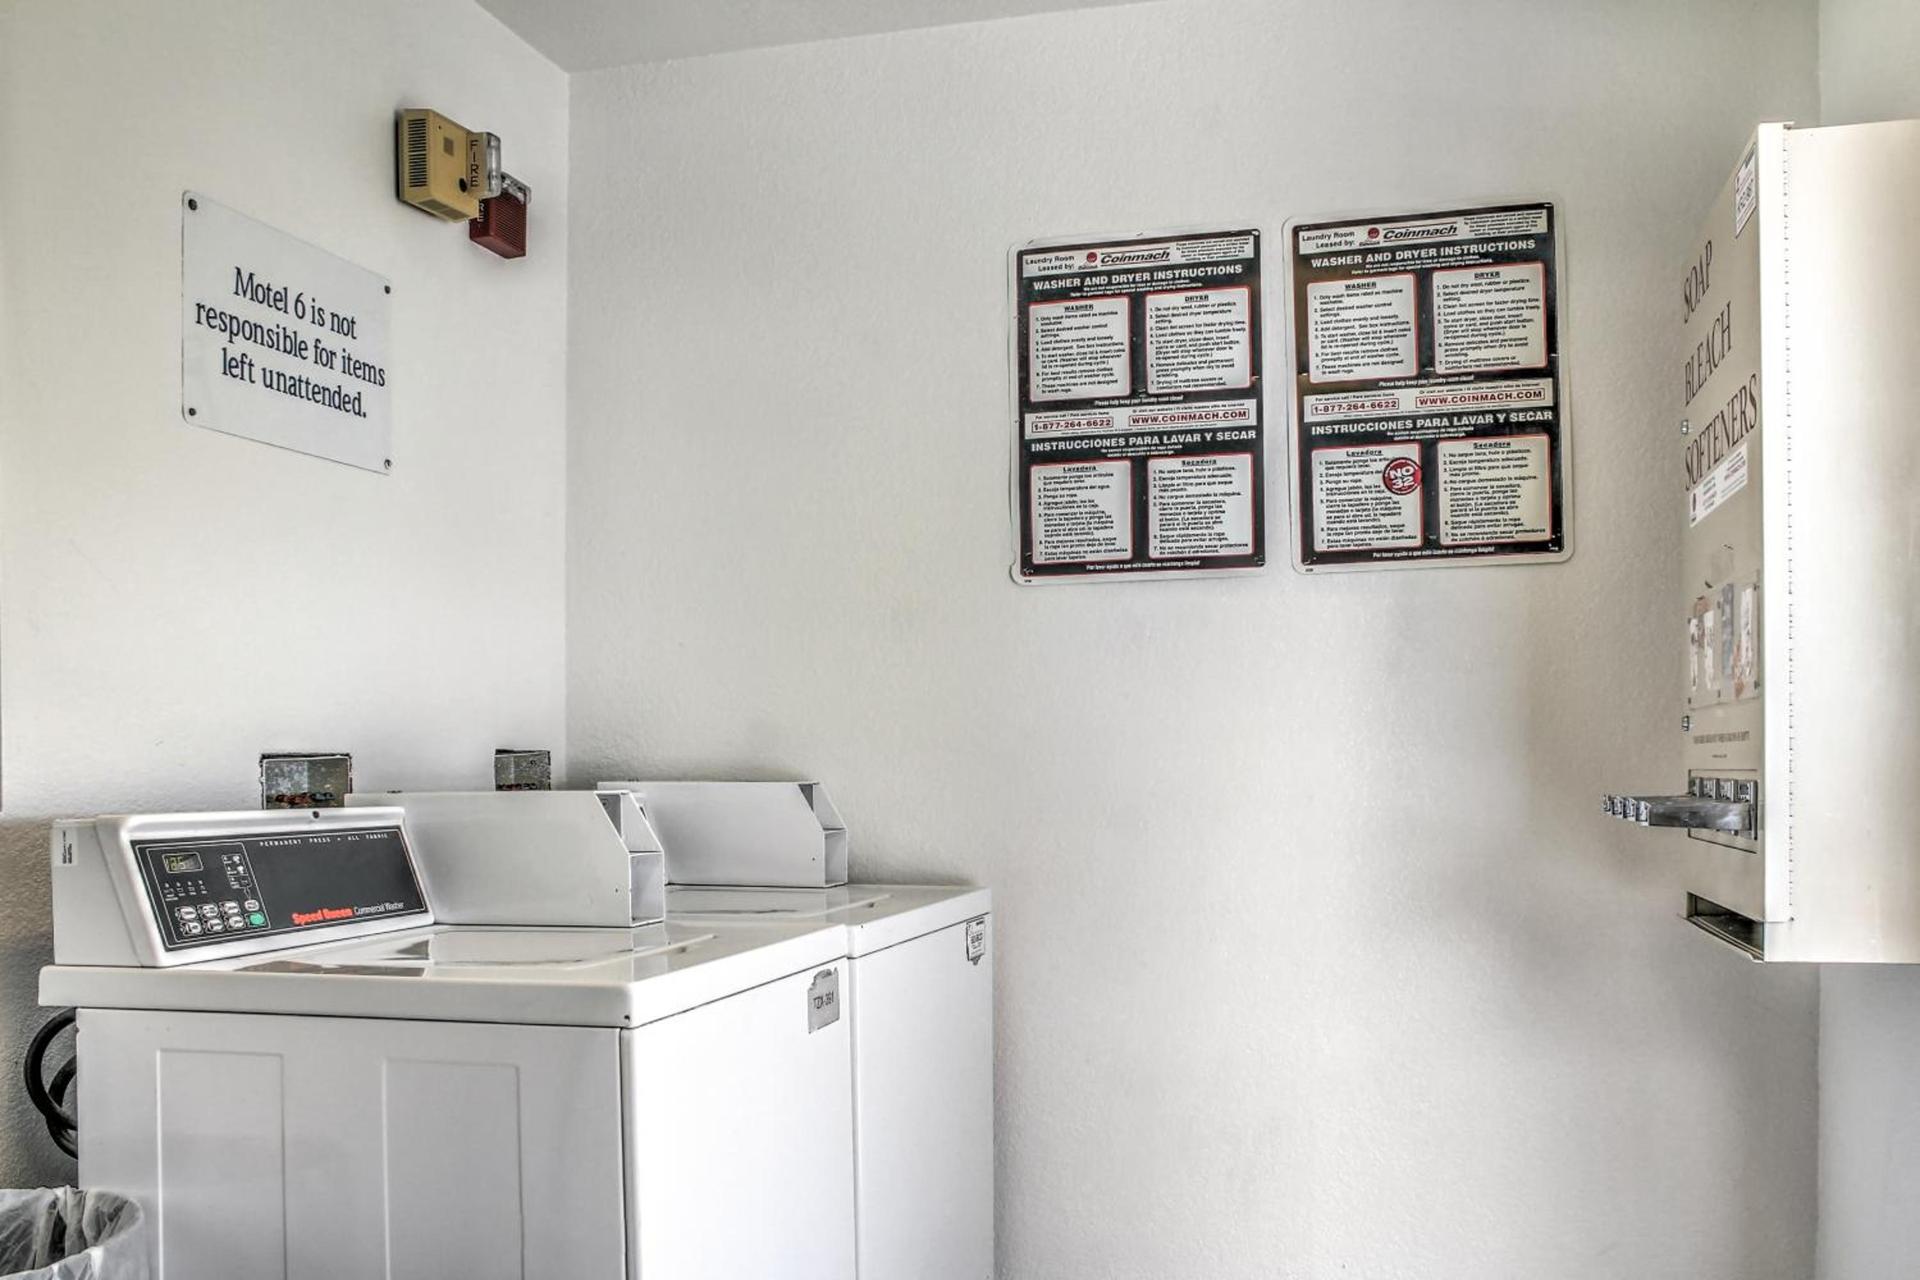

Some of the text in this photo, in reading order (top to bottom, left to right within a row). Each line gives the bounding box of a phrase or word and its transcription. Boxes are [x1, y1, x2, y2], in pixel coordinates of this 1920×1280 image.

[470, 140, 480, 187] FIRE
[1302, 233, 1332, 241] Laundry
[1383, 225, 1457, 239] Coinmach
[1316, 240, 1342, 248] Leased
[1344, 239, 1354, 247] by:
[1025, 256, 1053, 265] Laundry
[1101, 250, 1170, 263] Coinmach
[1311, 256, 1362, 268] WASHER
[1366, 252, 1392, 262] AND
[1395, 248, 1437, 260] DRYER
[1441, 240, 1536, 256] INSTRUCTIONS
[1033, 278, 1080, 290] WASHER
[1084, 276, 1108, 285] AND
[1112, 272, 1150, 283] DRYER
[1154, 264, 1242, 280] INSTRUCTIONS
[1038, 264, 1063, 272] Leased
[1064, 262, 1074, 270] by:
[1345, 282, 1376, 290] WASHER
[1684, 240, 1712, 324] SOAP
[233, 266, 357, 339] Motel 6 is not
[195, 303, 385, 387] responsible for items
[1684, 300, 1731, 407] BLEACH
[222, 348, 367, 418] left unattended.
[1314, 401, 1397, 413] 1-877-264-6622
[1419, 391, 1541, 405] WWW.COINMACH.COM
[1132, 411, 1246, 424] WWW.COINMACH.COM
[1312, 420, 1413, 435] INSTRUCCIONES
[1417, 418, 1449, 427] PARA
[1453, 415, 1493, 426] LAVAR
[1496, 414, 1506, 422] Y
[1510, 411, 1553, 422] SECAR
[1031, 438, 1126, 452] INSTRUCCIONES
[1129, 436, 1159, 445] PARA
[1163, 434, 1201, 444] LAVAR
[1205, 432, 1212, 441] Y
[1216, 430, 1256, 440] SECAR
[1685, 373, 1757, 492] SOFTENERS
[1390, 466, 1414, 478] NO
[1393, 476, 1414, 488] 32
[292, 908, 324, 926] Speed
[322, 908, 354, 920] Queen
